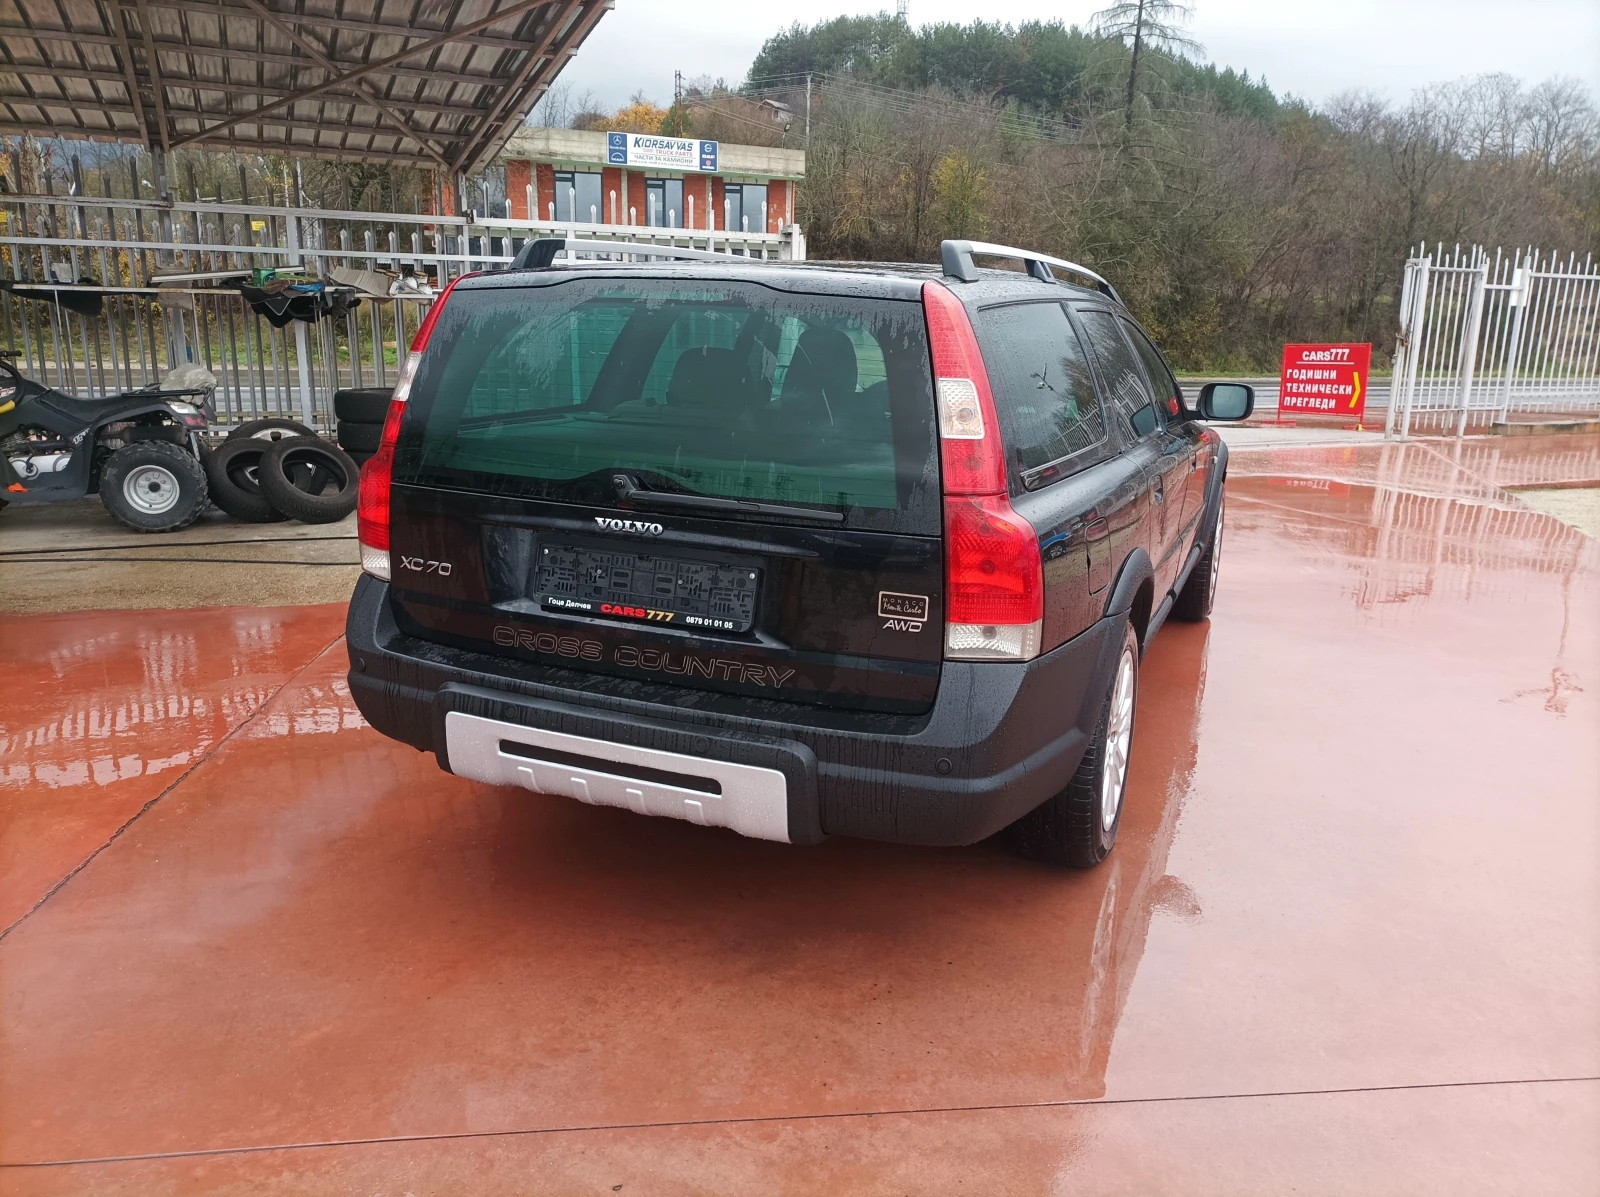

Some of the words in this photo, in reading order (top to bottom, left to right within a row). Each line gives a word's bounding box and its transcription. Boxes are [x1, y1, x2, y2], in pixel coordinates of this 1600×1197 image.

[633, 137, 693, 151] KIORSAVVAS
[663, 156, 693, 164] КАМИОНИ
[1302, 348, 1350, 361] CARS777
[1286, 369, 1337, 380] ГОДИШНИ
[1286, 383, 1353, 395] ТЕХНИЧЕСКИ
[1283, 396, 1336, 409] ПРЕГЛЕДИ
[594, 517, 663, 536] VOLVO
[548, 597, 564, 606] Гоце
[882, 597, 924, 606] MONACO
[903, 604, 922, 614] Carlo
[686, 616, 703, 625] 0879
[704, 618, 712, 626] 01
[714, 619, 722, 627] 01
[724, 621, 733, 629] 05
[882, 619, 922, 632] AWD
[492, 625, 603, 661] CROSS
[614, 645, 796, 688] COUNTRY
